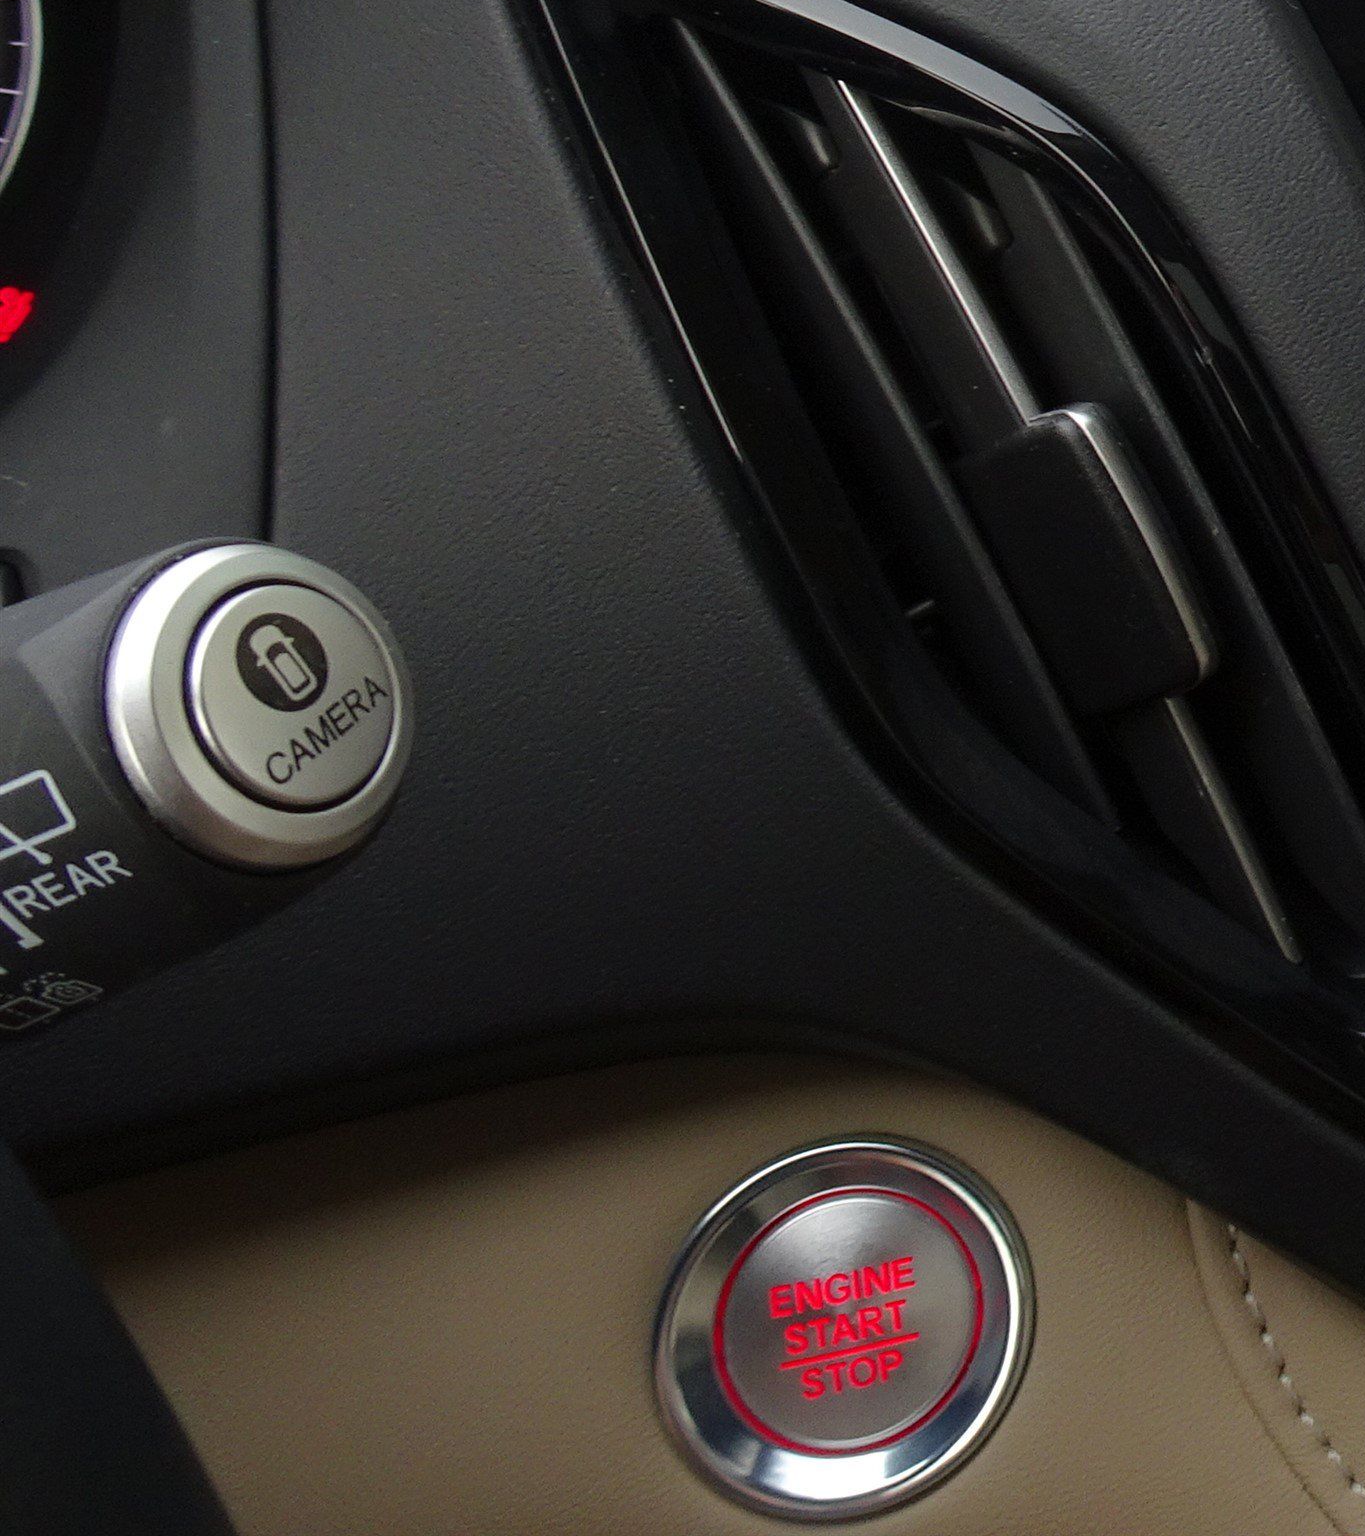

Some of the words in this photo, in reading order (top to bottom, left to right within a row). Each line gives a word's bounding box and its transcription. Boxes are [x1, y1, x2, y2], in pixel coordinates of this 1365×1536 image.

[264, 675, 389, 786] CAMERA
[2, 849, 134, 918] REAR
[767, 1255, 917, 1319] ENGINE
[783, 1298, 908, 1356] START
[800, 1349, 905, 1401] STOP
